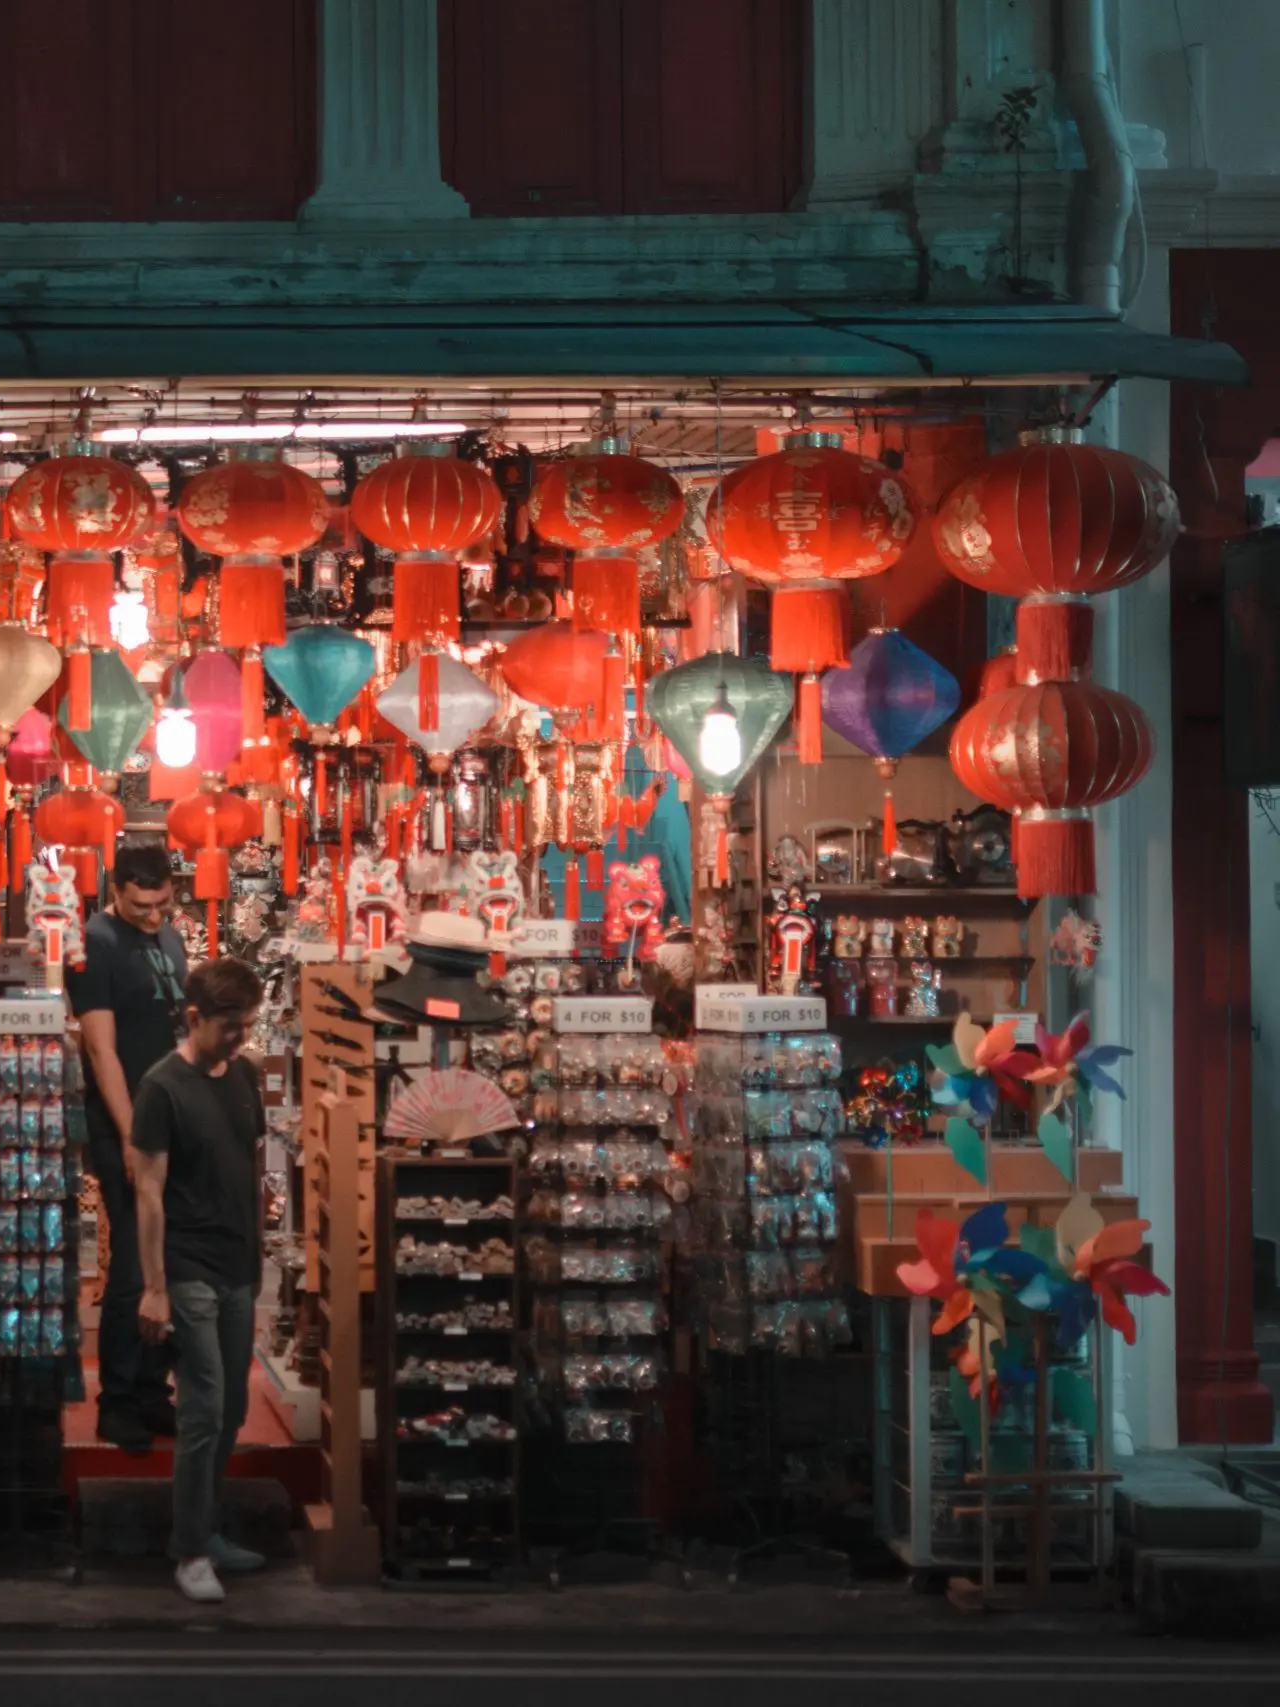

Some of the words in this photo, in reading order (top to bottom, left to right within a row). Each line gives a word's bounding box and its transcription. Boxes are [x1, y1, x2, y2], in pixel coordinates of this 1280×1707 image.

[525, 928, 559, 942] FOR
[571, 928, 599, 943] $10
[1, 1013, 32, 1025] FOR
[38, 1012, 54, 1025] $1
[564, 1011, 572, 1023] 4
[581, 1012, 613, 1023] FOR
[621, 1011, 646, 1024] $10
[747, 1011, 756, 1023] 5
[762, 1010, 791, 1022] FOR
[798, 1008, 821, 1021] $10
